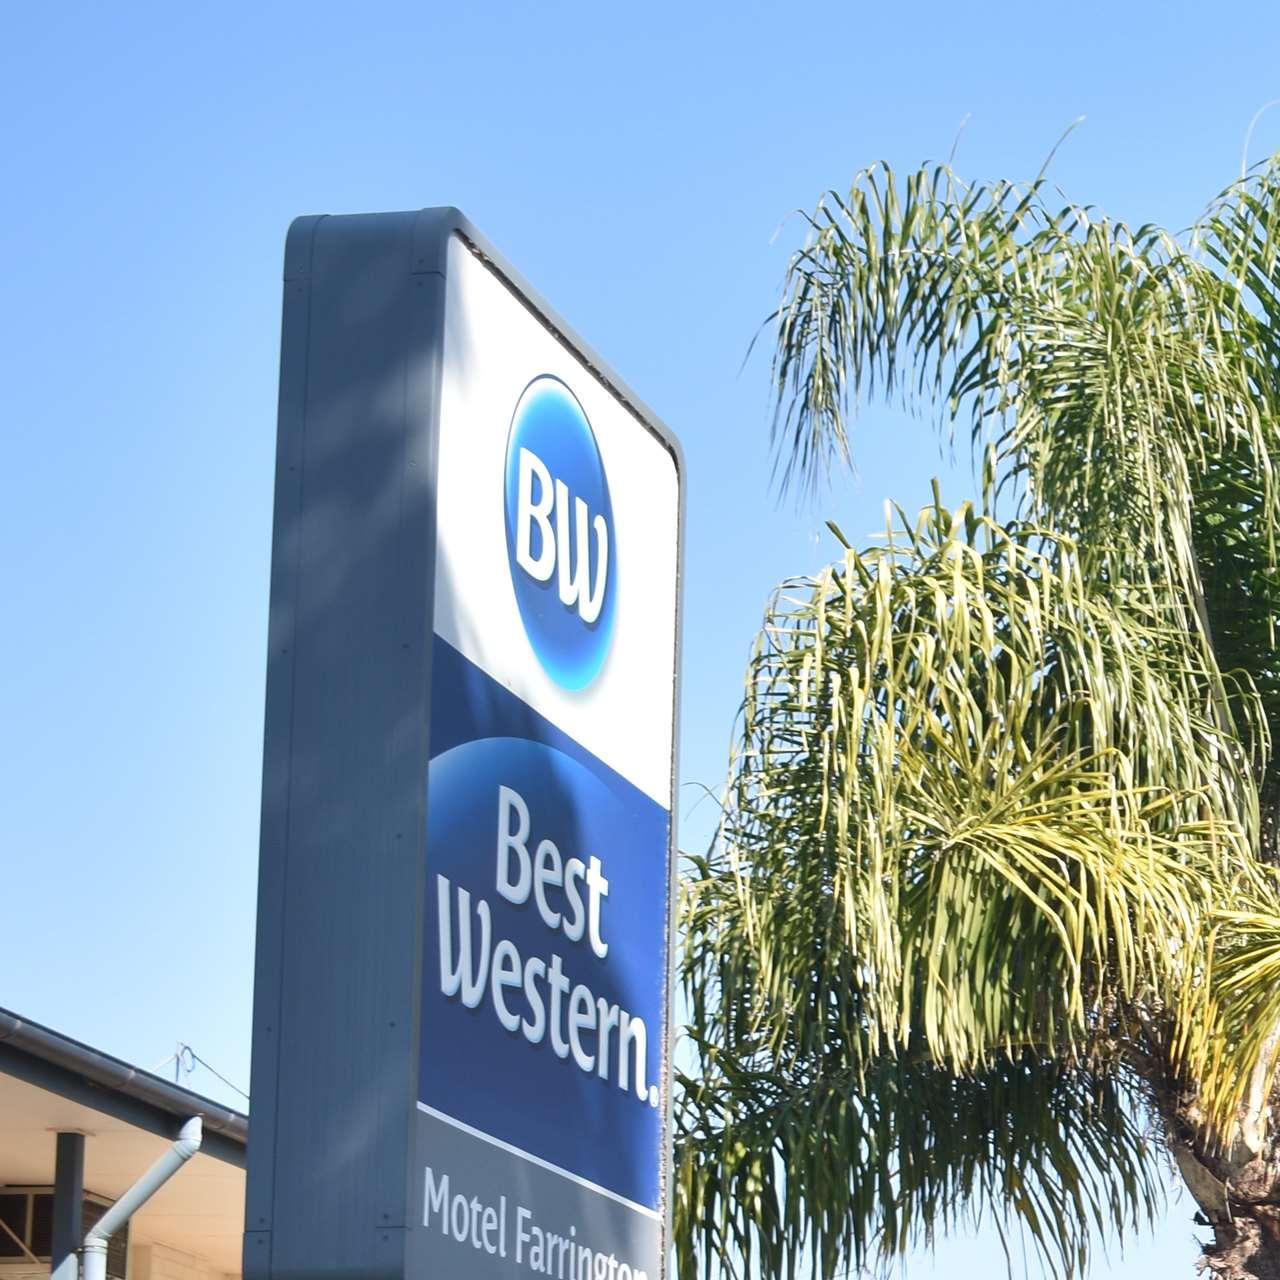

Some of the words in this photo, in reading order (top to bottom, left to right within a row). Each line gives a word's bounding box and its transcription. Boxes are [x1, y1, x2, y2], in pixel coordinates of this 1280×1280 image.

[516, 447, 608, 623] BW
[496, 785, 609, 959] Best
[423, 1166, 506, 1258] Motel
